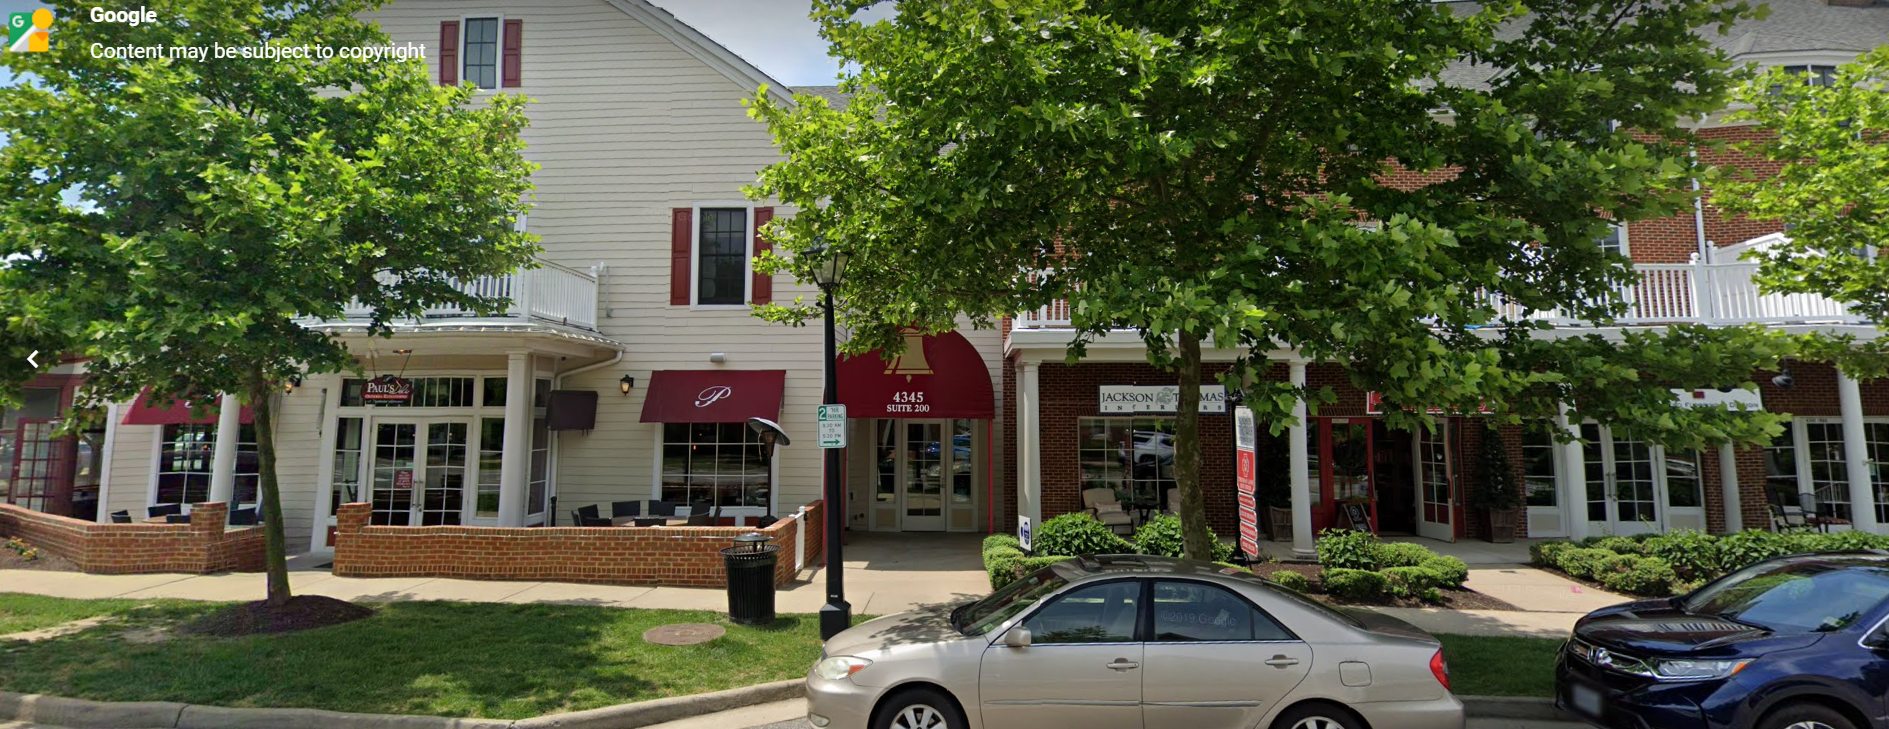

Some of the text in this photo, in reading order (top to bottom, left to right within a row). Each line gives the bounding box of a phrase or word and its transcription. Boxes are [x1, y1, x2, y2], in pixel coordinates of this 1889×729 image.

[367, 383, 395, 393] PAUL'S
[694, 385, 732, 408] P
[893, 391, 924, 403] 4345
[1102, 392, 1224, 403] JACKSON TMAS
[819, 407, 826, 420] 2
[886, 404, 930, 412] SUITE 200
